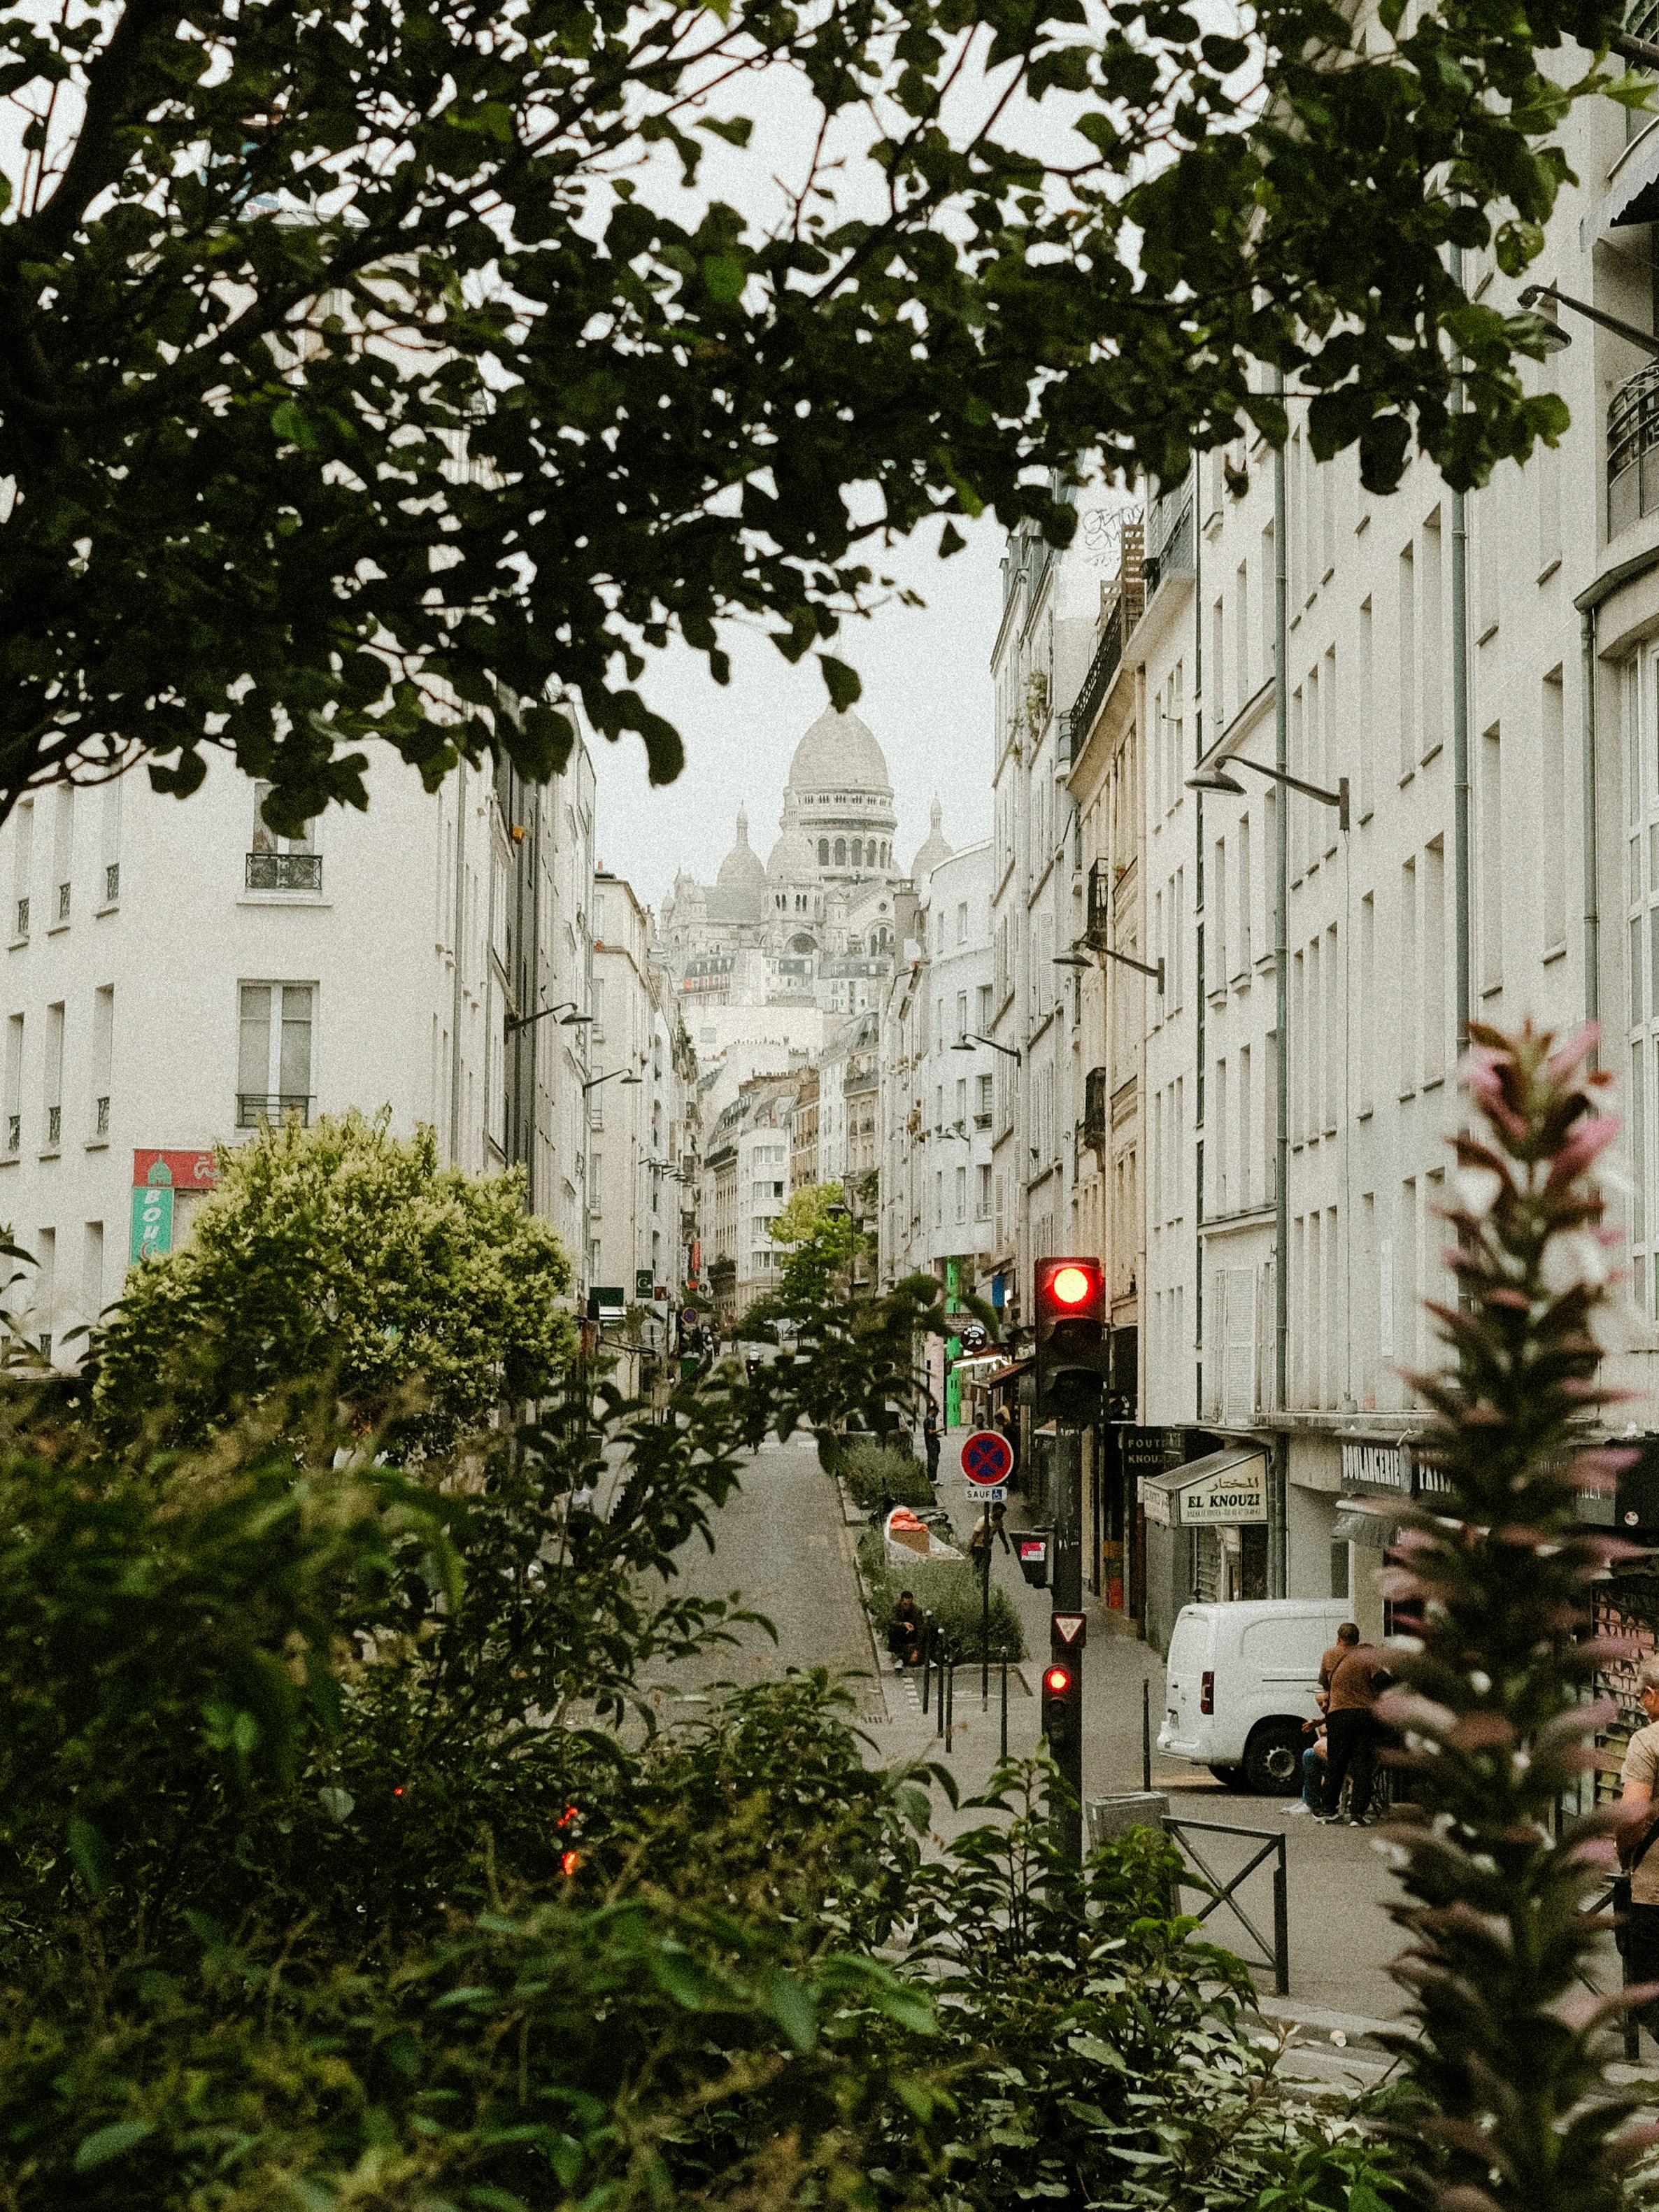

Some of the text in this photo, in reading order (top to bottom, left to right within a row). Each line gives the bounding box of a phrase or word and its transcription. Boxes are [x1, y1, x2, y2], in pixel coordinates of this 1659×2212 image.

[1342, 1444, 1400, 1487] BOULANGERIE
[1206, 1476, 1259, 1492] المختار
[967, 1489, 990, 1498] SAUF
[1188, 1494, 1260, 1508] EL KNOUZI
